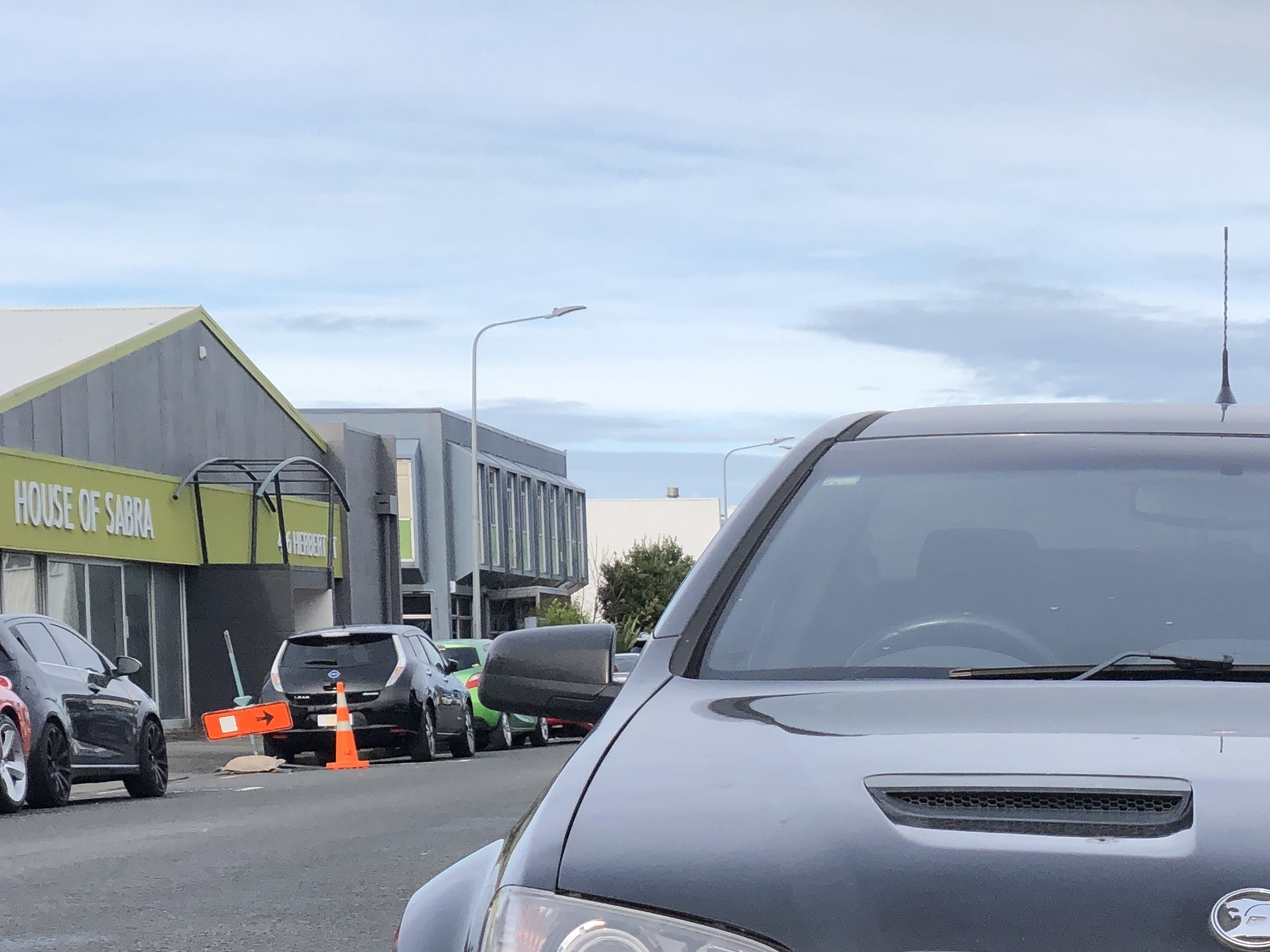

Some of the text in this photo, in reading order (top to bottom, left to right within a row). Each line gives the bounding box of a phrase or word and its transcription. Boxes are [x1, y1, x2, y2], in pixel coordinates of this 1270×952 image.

[14, 479, 155, 539] HOUSE OF SABRA
